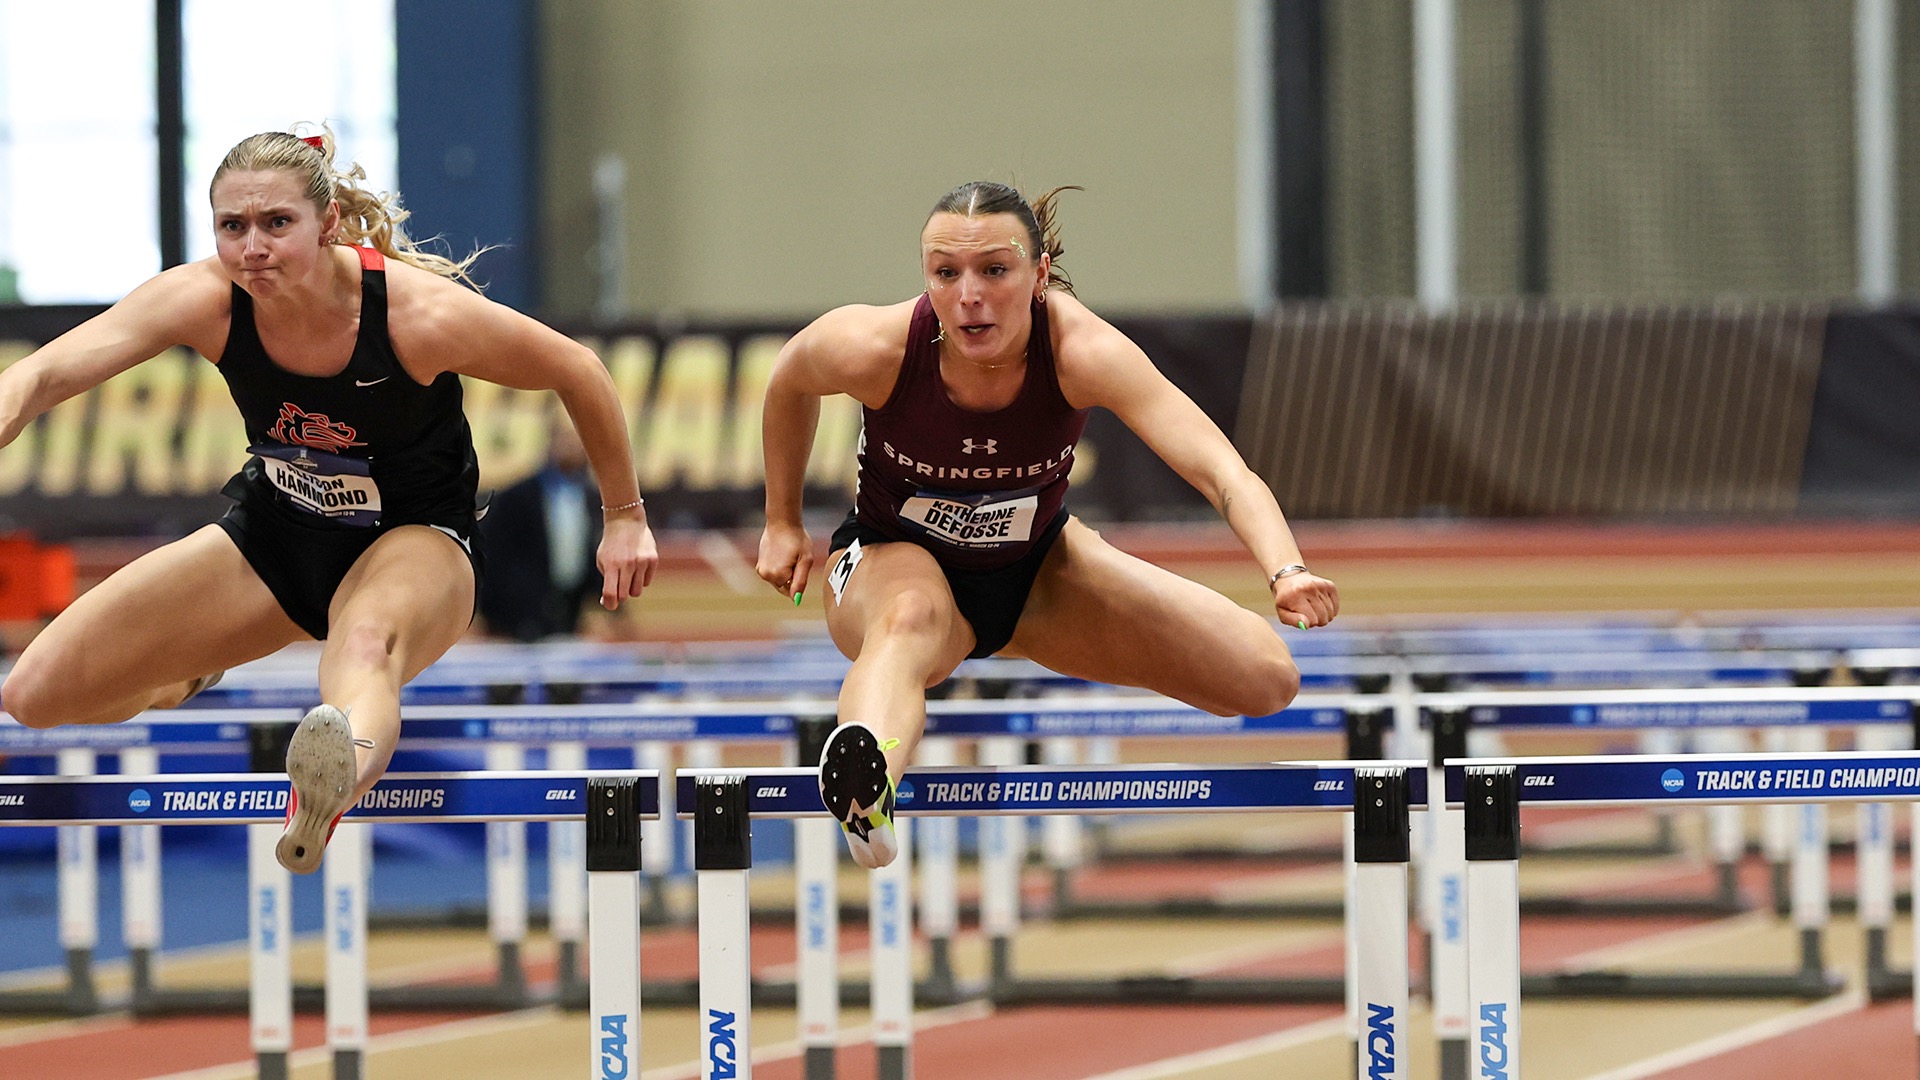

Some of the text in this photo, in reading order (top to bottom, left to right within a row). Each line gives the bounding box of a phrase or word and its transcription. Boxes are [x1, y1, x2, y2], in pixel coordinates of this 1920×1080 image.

[883, 441, 1072, 479] SPRINGFIELD
[276, 467, 368, 508] HAMMOND
[923, 507, 1012, 540] DEFOSSE
[932, 500, 1017, 525] KATHERINE
[1313, 780, 1345, 791] GILL
[1523, 775, 1555, 787] GILL
[1663, 779, 1684, 787] NCAA
[1696, 766, 1920, 791] TRACK & FIELD CHAMPIO
[163, 791, 221, 811] TRACK
[222, 790, 236, 810] &
[239, 790, 288, 810] FIELD
[545, 790, 576, 800] GILL
[756, 787, 787, 798] GILL
[926, 779, 1212, 803] TRACK & FIELD CHAMPIONSHIPS
[130, 800, 151, 808] NCAA
[1367, 1002, 1395, 1080] NCA
